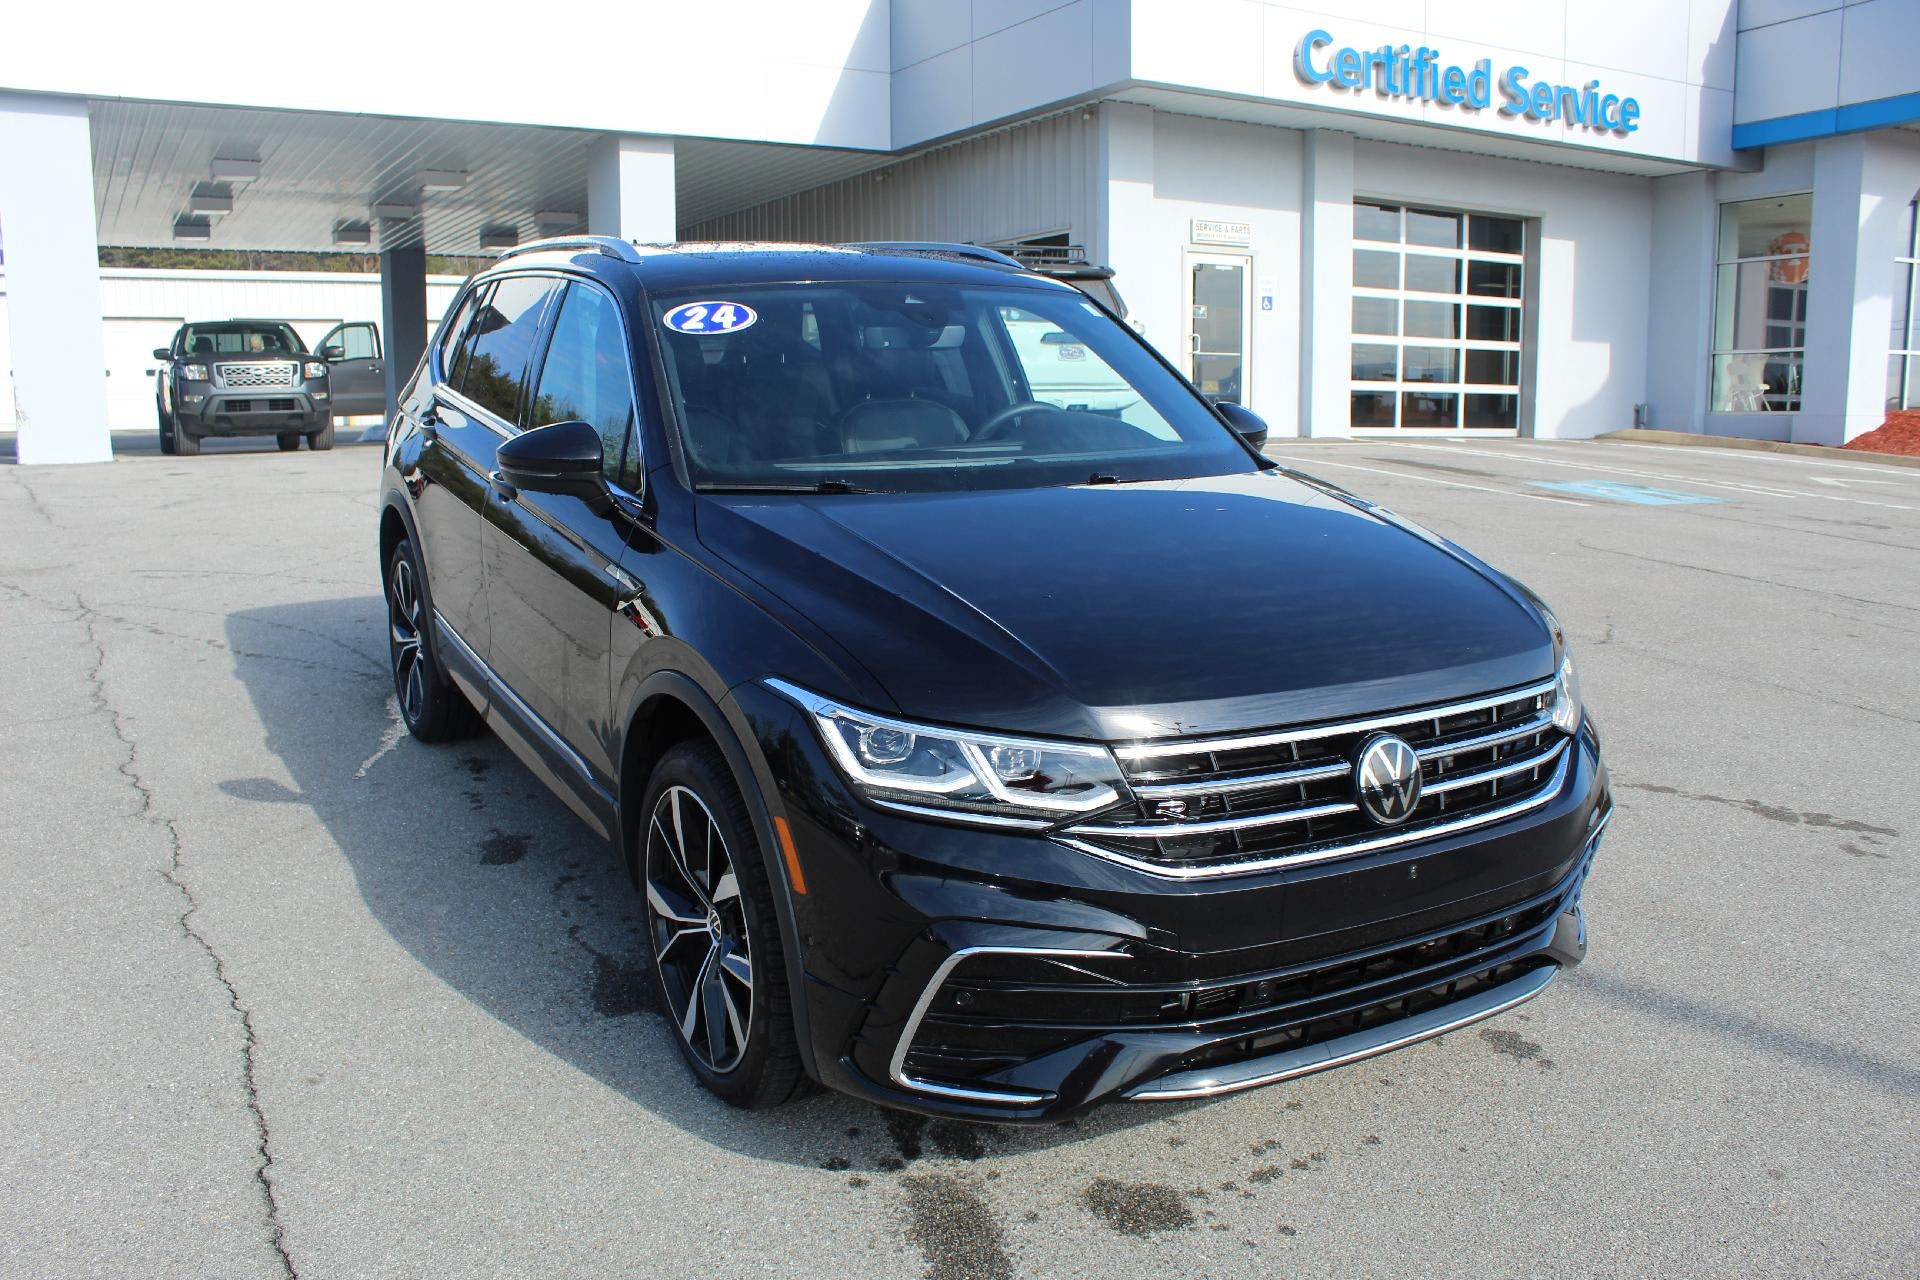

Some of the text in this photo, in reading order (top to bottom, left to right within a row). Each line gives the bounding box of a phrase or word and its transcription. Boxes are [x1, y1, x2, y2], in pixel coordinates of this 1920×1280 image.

[1294, 29, 1640, 133] Certified Service
[1195, 223, 1222, 233] SERVICE
[681, 305, 737, 330] 24
